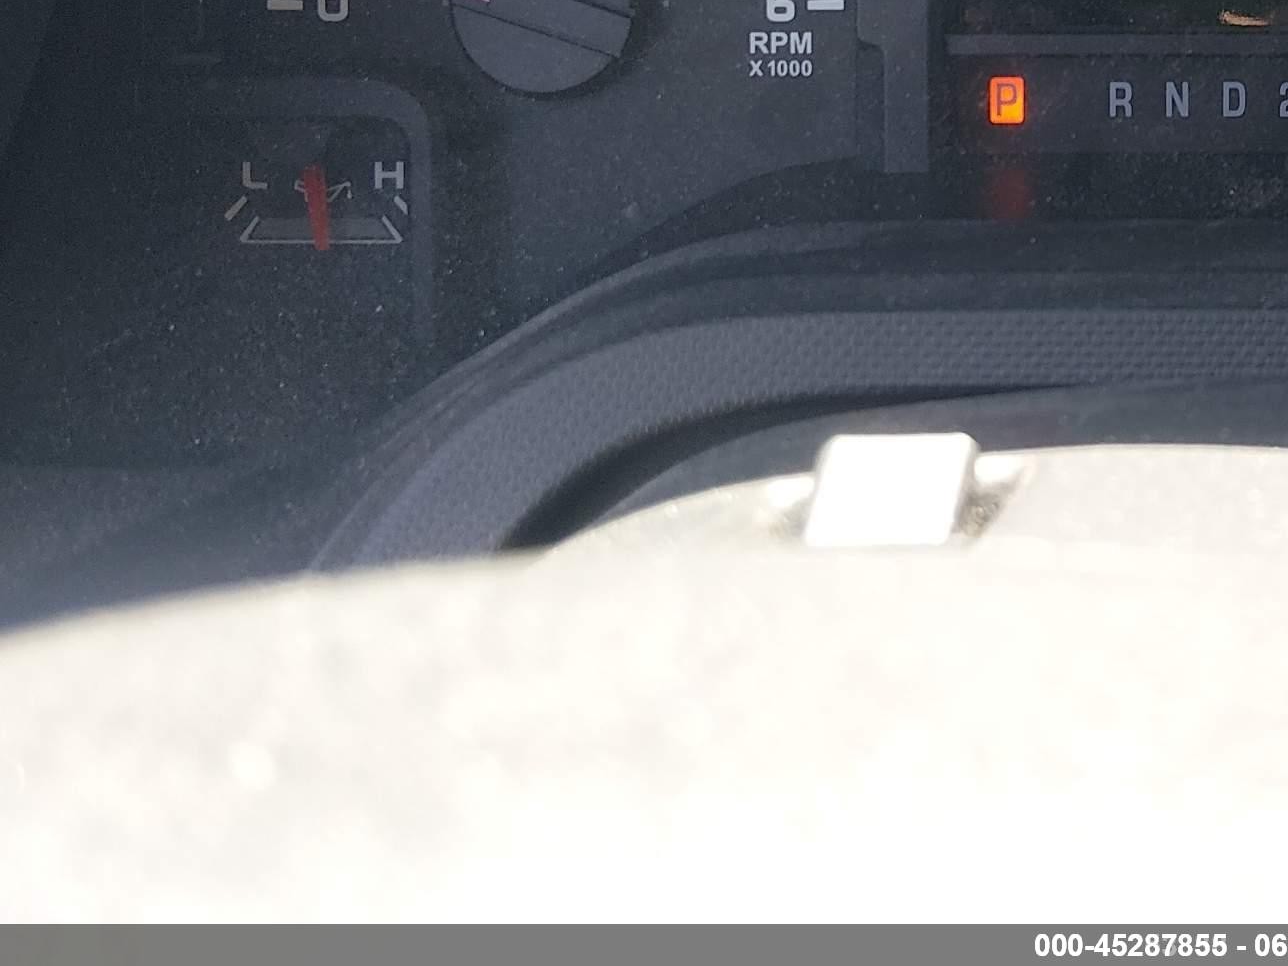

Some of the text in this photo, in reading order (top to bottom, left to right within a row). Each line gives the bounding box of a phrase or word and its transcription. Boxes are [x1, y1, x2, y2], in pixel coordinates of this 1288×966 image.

[749, 32, 812, 54] RPM
[995, 82, 1018, 117] P
[1110, 81, 1133, 118] R
[1166, 81, 1189, 118] N
[1223, 81, 1246, 118] D
[243, 161, 404, 190] L H
